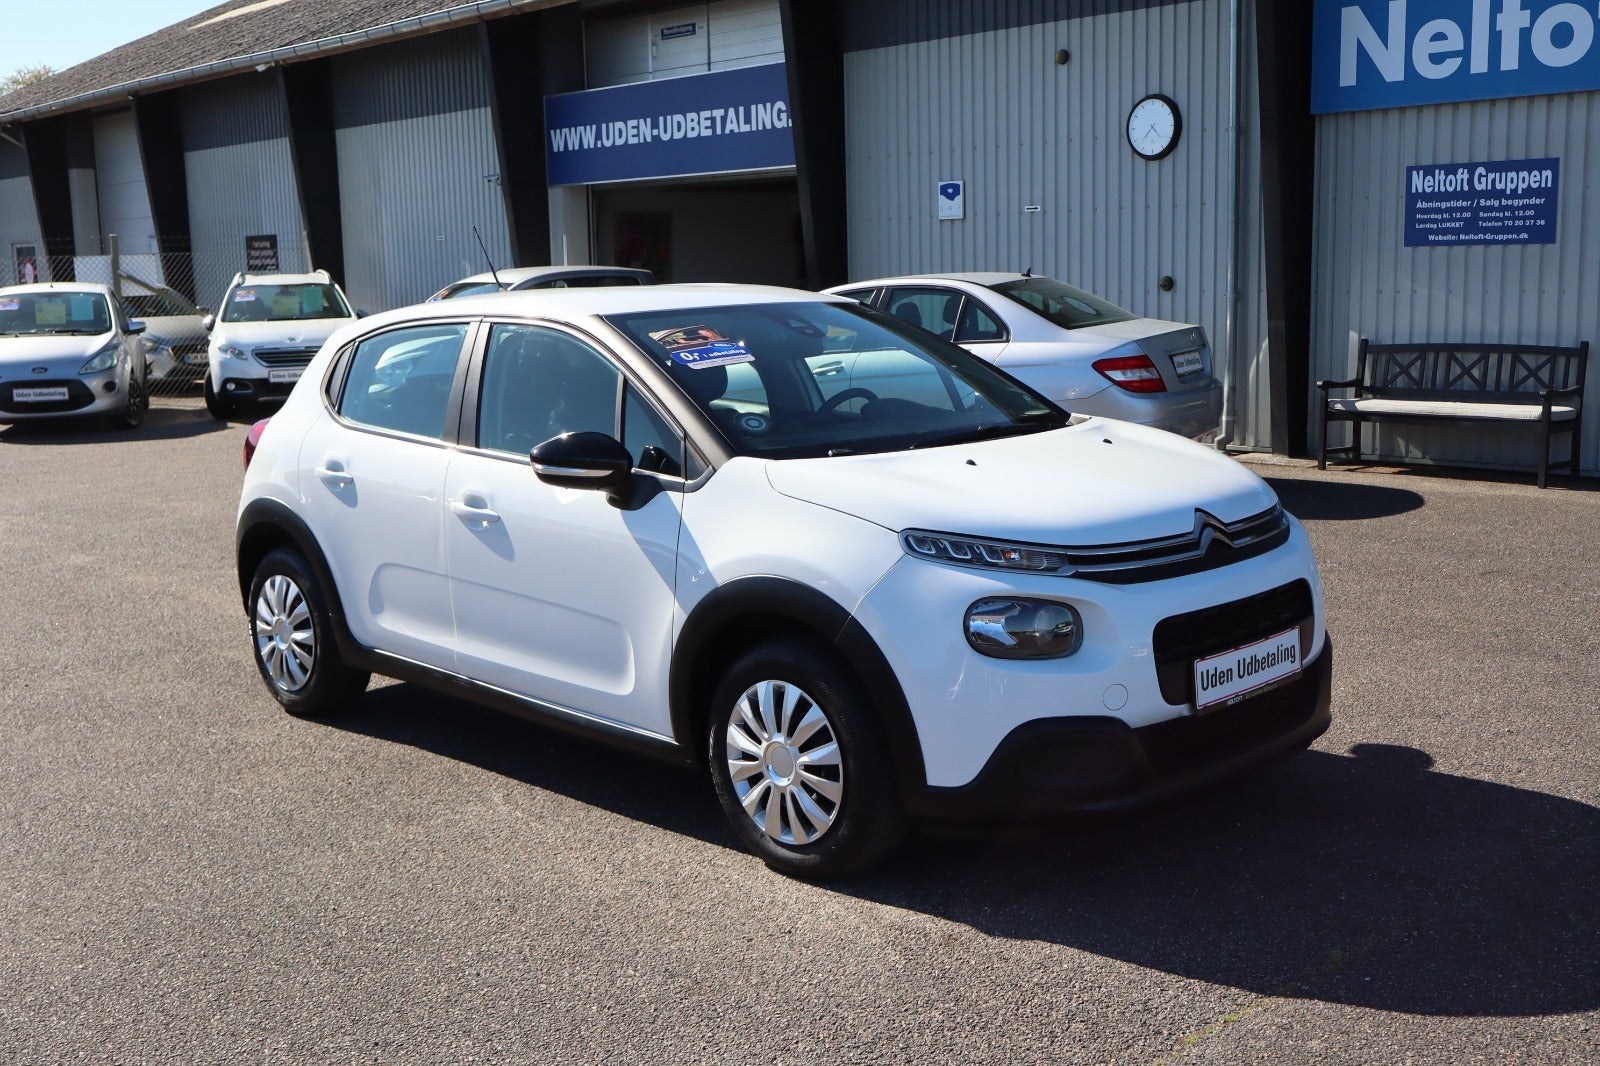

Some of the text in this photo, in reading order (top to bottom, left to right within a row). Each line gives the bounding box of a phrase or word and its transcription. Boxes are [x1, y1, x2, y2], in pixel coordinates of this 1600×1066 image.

[1339, 0, 1600, 87] Nelto
[1411, 166, 1552, 194] Neltoft Gruppen
[1416, 199, 1471, 209] Åbningstider
[1480, 198, 1499, 207] Salg
[1501, 197, 1545, 206] begynder
[1459, 232, 1529, 241] Neltoft-Gruppen.dk
[1200, 667, 1233, 691] Uden
[1237, 644, 1296, 680] Udbetaling
